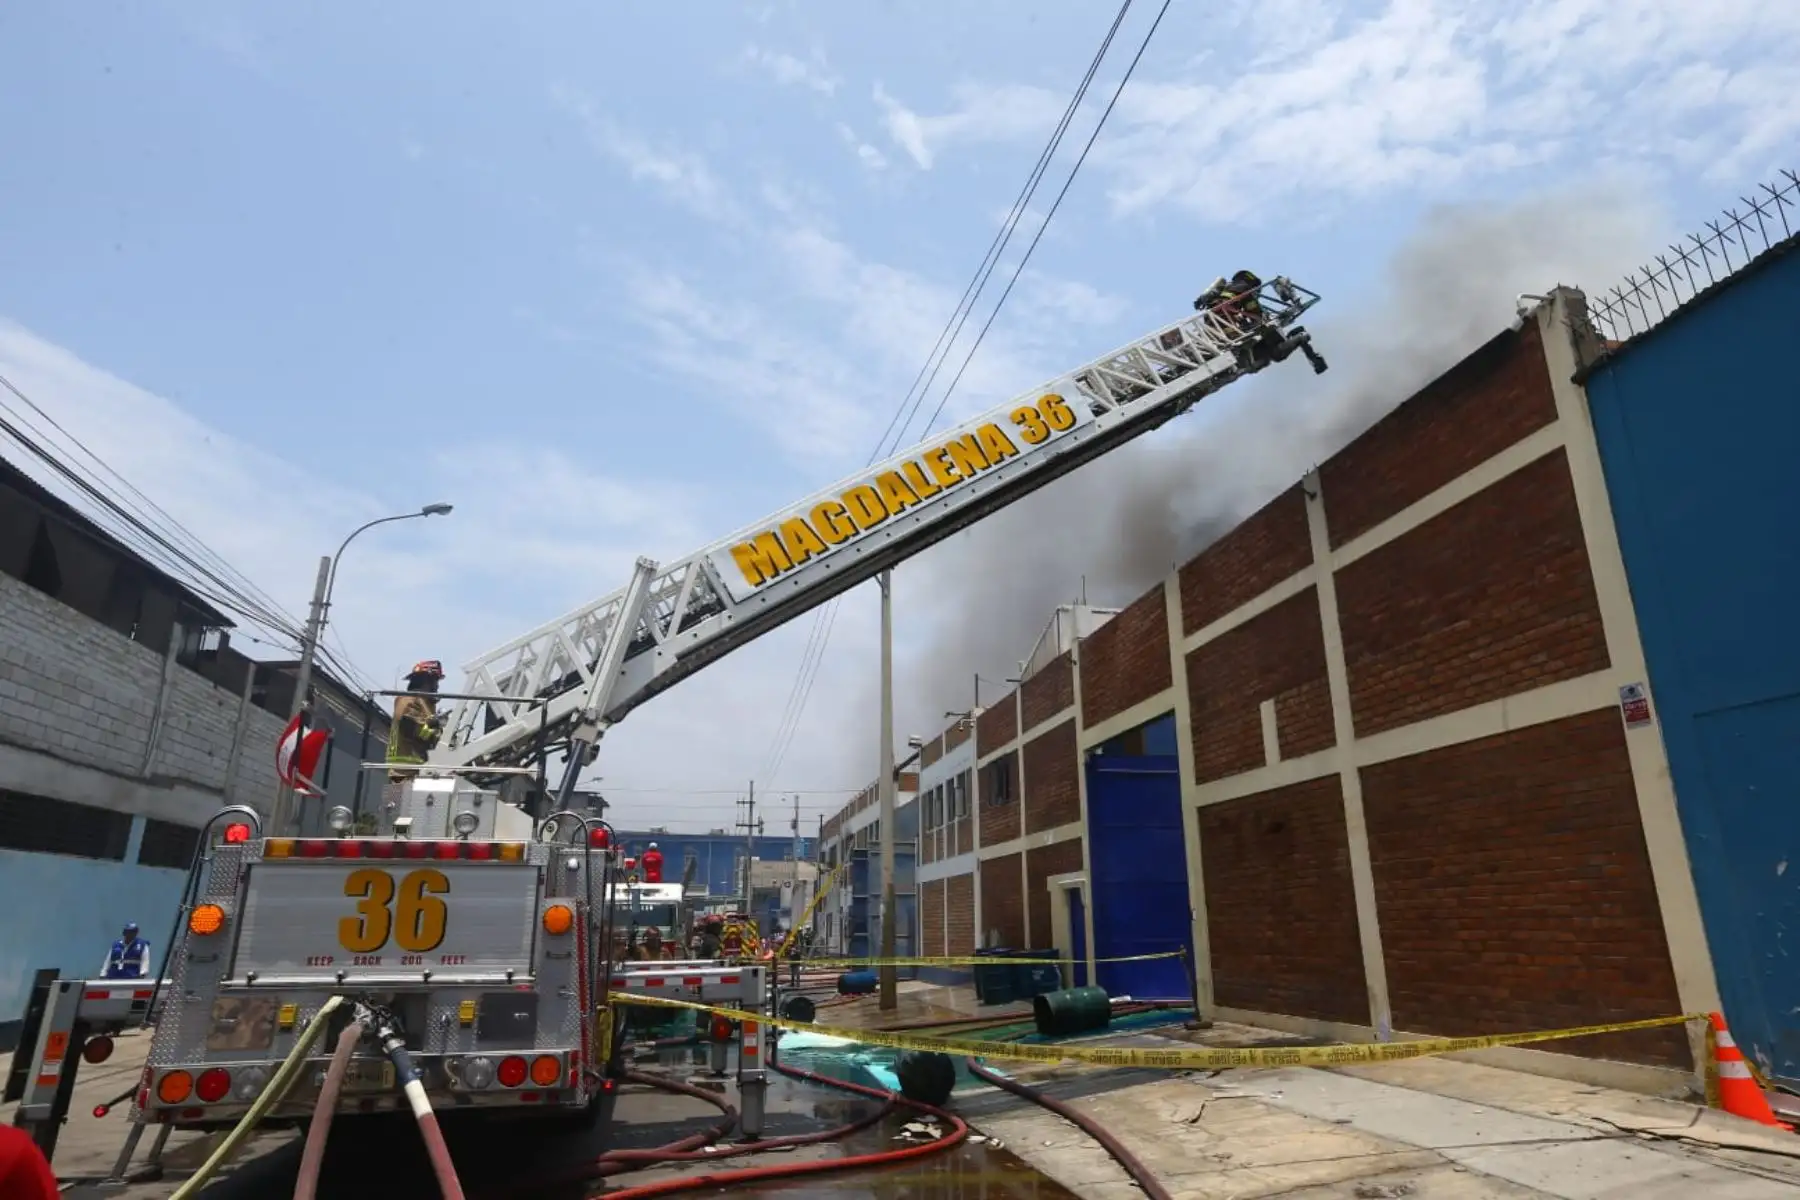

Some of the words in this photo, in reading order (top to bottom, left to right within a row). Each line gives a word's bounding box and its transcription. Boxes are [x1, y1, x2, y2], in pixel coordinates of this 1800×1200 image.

[729, 422, 1020, 587] MAGDALENA
[1009, 393, 1077, 445] 36
[338, 868, 451, 953] 36
[306, 955, 335, 966] KEEP
[401, 955, 422, 965] 200
[440, 955, 467, 965] FEET
